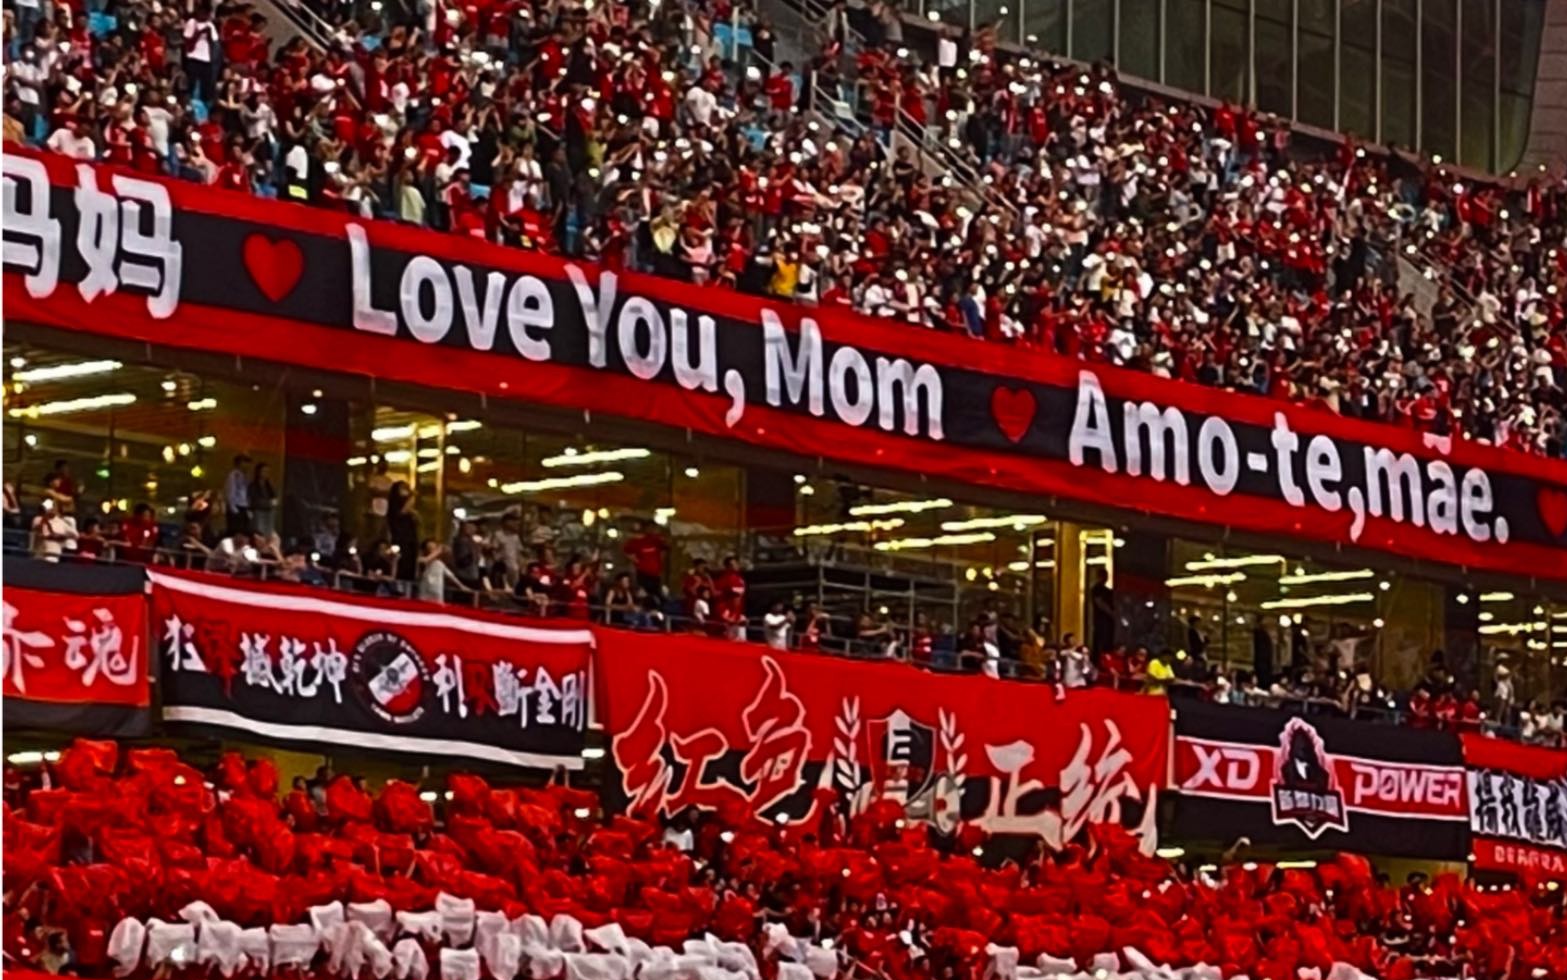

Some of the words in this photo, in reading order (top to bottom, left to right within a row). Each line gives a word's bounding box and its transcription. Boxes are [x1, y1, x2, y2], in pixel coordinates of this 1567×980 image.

[345, 222, 553, 361] Love
[761, 308, 945, 440] Mom
[1182, 743, 1261, 790] XD
[1350, 761, 1461, 809] POWER
